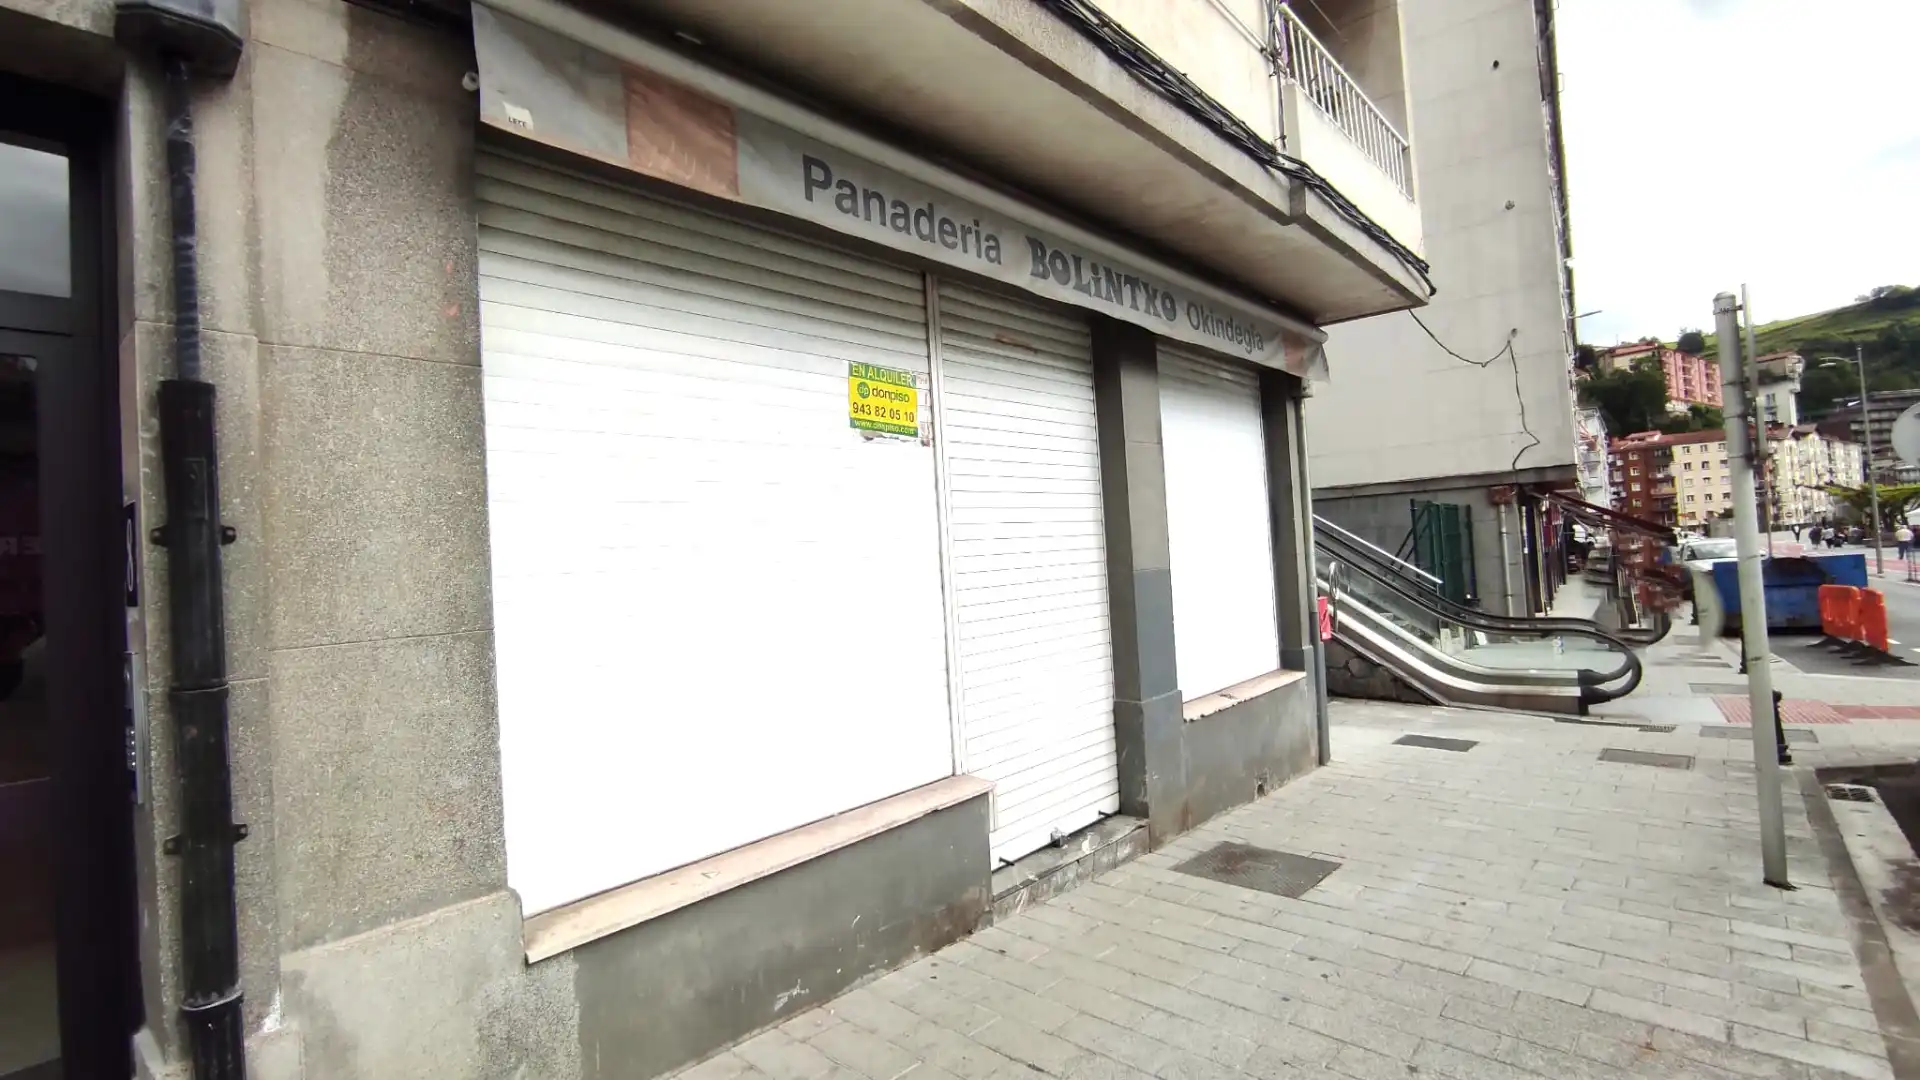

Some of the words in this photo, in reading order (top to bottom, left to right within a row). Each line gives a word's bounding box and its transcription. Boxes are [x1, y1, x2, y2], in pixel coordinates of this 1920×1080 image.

[802, 154, 1002, 265] Panaderia
[1187, 301, 1264, 354] Okindegia
[853, 363, 865, 377] EN
[868, 367, 915, 387] ALQUILER
[871, 386, 910, 403] donpiso
[853, 402, 871, 415] 943
[875, 406, 886, 418] 82
[890, 408, 900, 420] 05
[904, 412, 914, 422] 10
